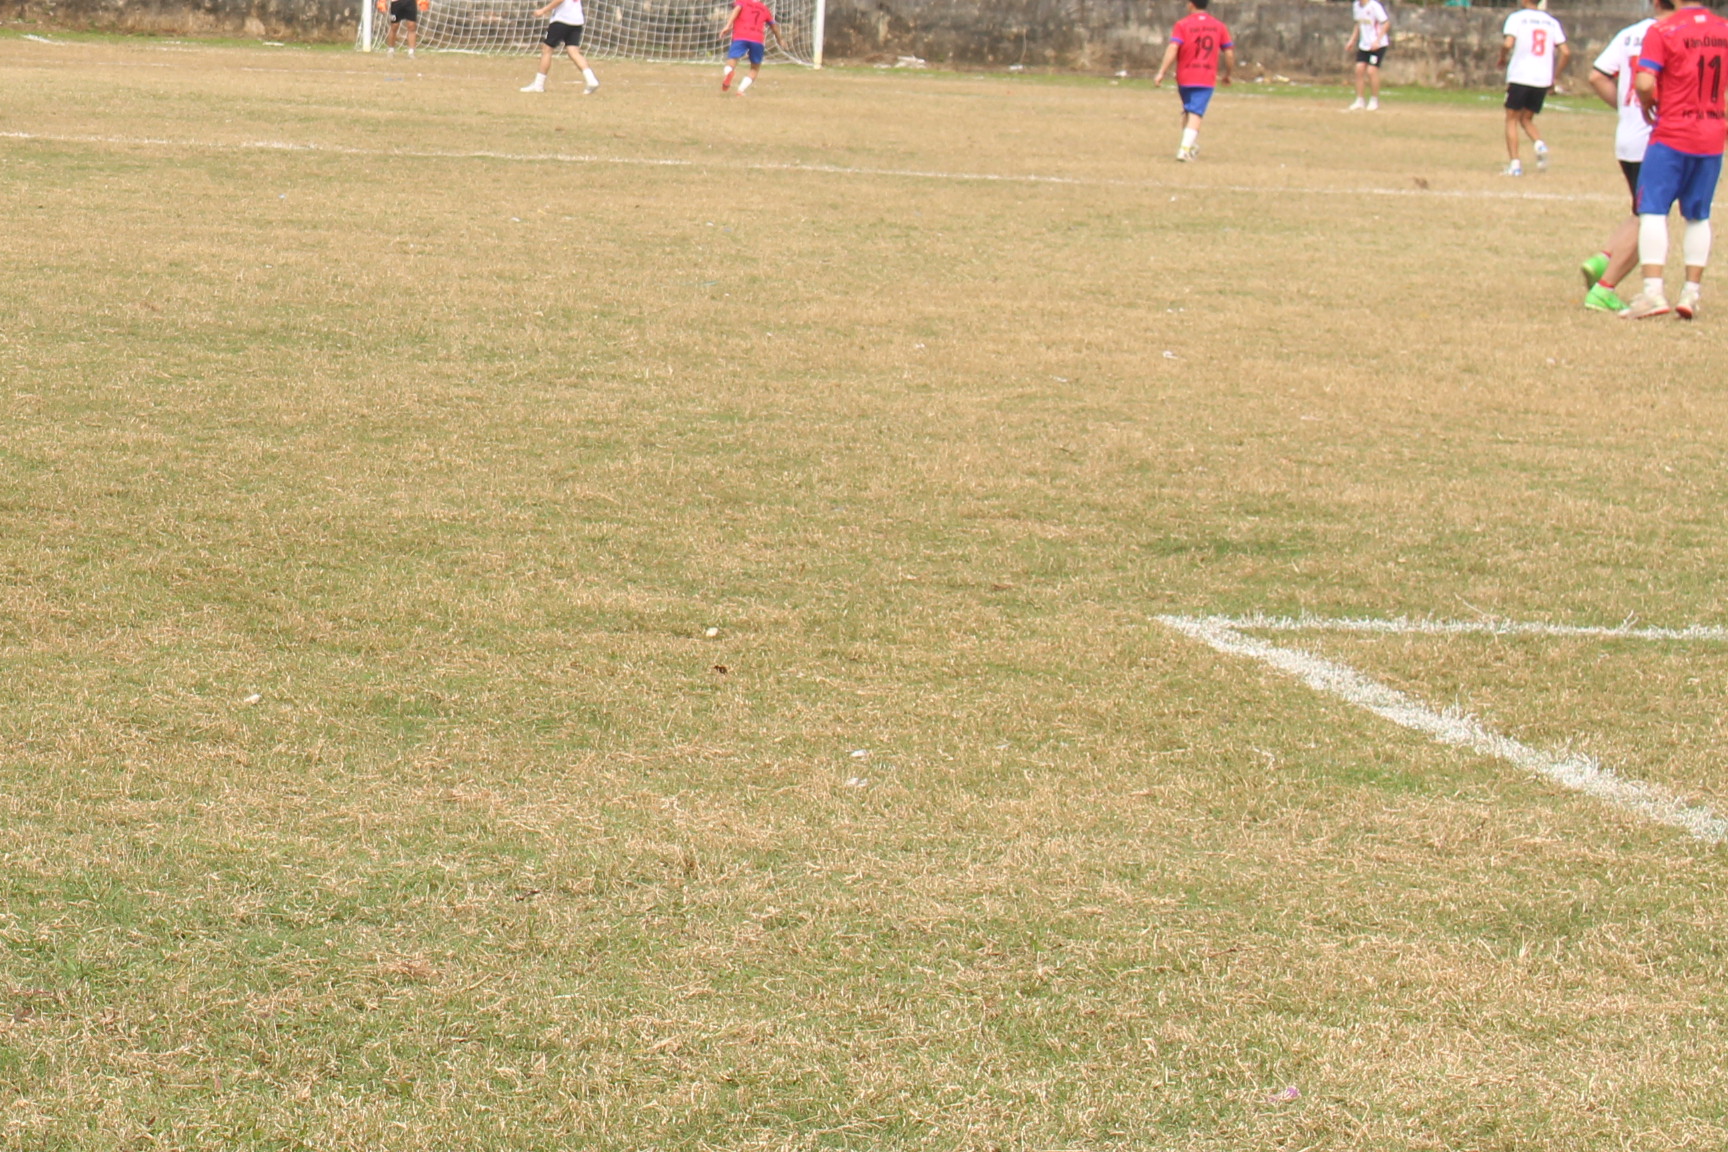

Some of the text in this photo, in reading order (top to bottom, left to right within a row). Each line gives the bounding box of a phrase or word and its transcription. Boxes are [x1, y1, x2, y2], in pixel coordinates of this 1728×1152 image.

[752, 10, 760, 25] 7
[1194, 35, 1214, 59] 19
[1532, 29, 1547, 57] 8
[1697, 54, 1721, 104] 11
